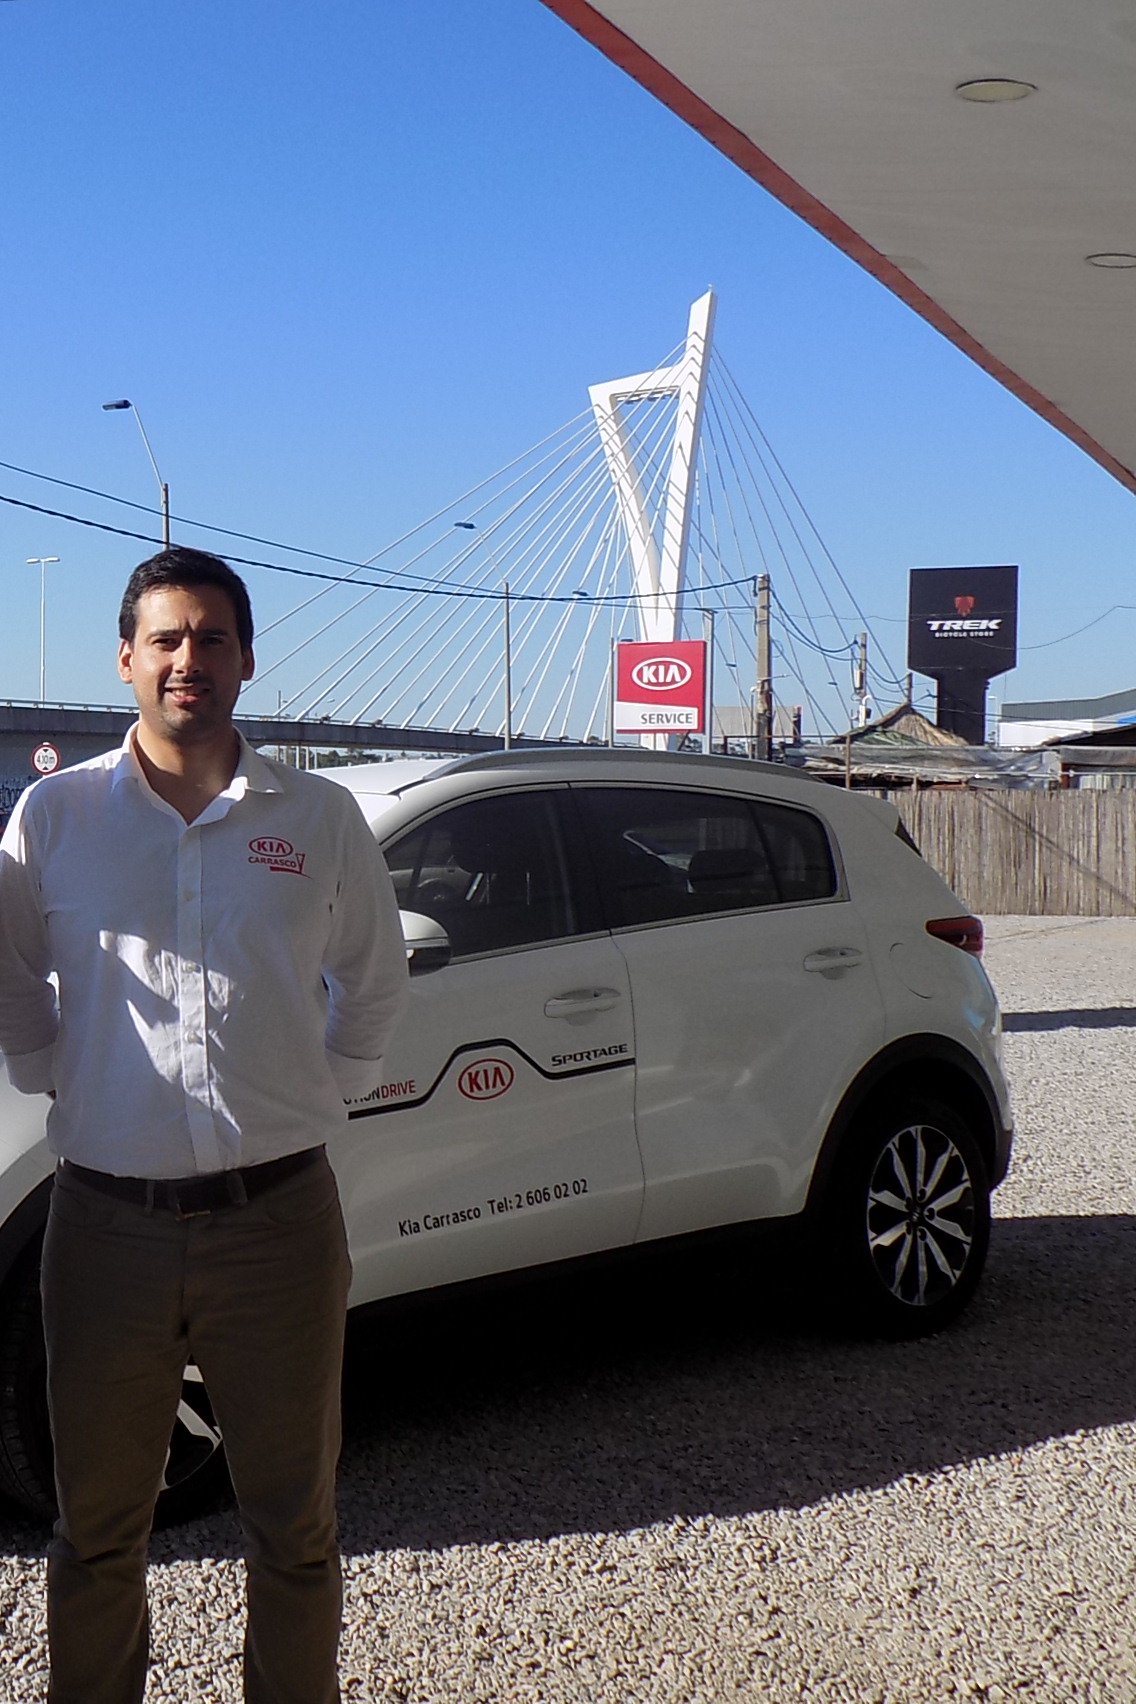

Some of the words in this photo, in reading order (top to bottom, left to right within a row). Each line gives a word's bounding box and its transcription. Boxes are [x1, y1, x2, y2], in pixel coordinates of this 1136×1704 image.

[926, 619, 1003, 631] TREK
[642, 664, 682, 683] KIA
[640, 712, 693, 725] SERVICE
[257, 840, 287, 854] KIA
[248, 856, 298, 869] CARRASCO
[551, 1043, 628, 1067] SPORTAGE
[467, 1066, 506, 1093] KIA
[398, 1220, 421, 1237] Kia
[423, 1206, 482, 1231] Carrasco
[526, 1186, 551, 1206] 606
[554, 1183, 570, 1200] 02
[572, 1178, 589, 1195] 02
